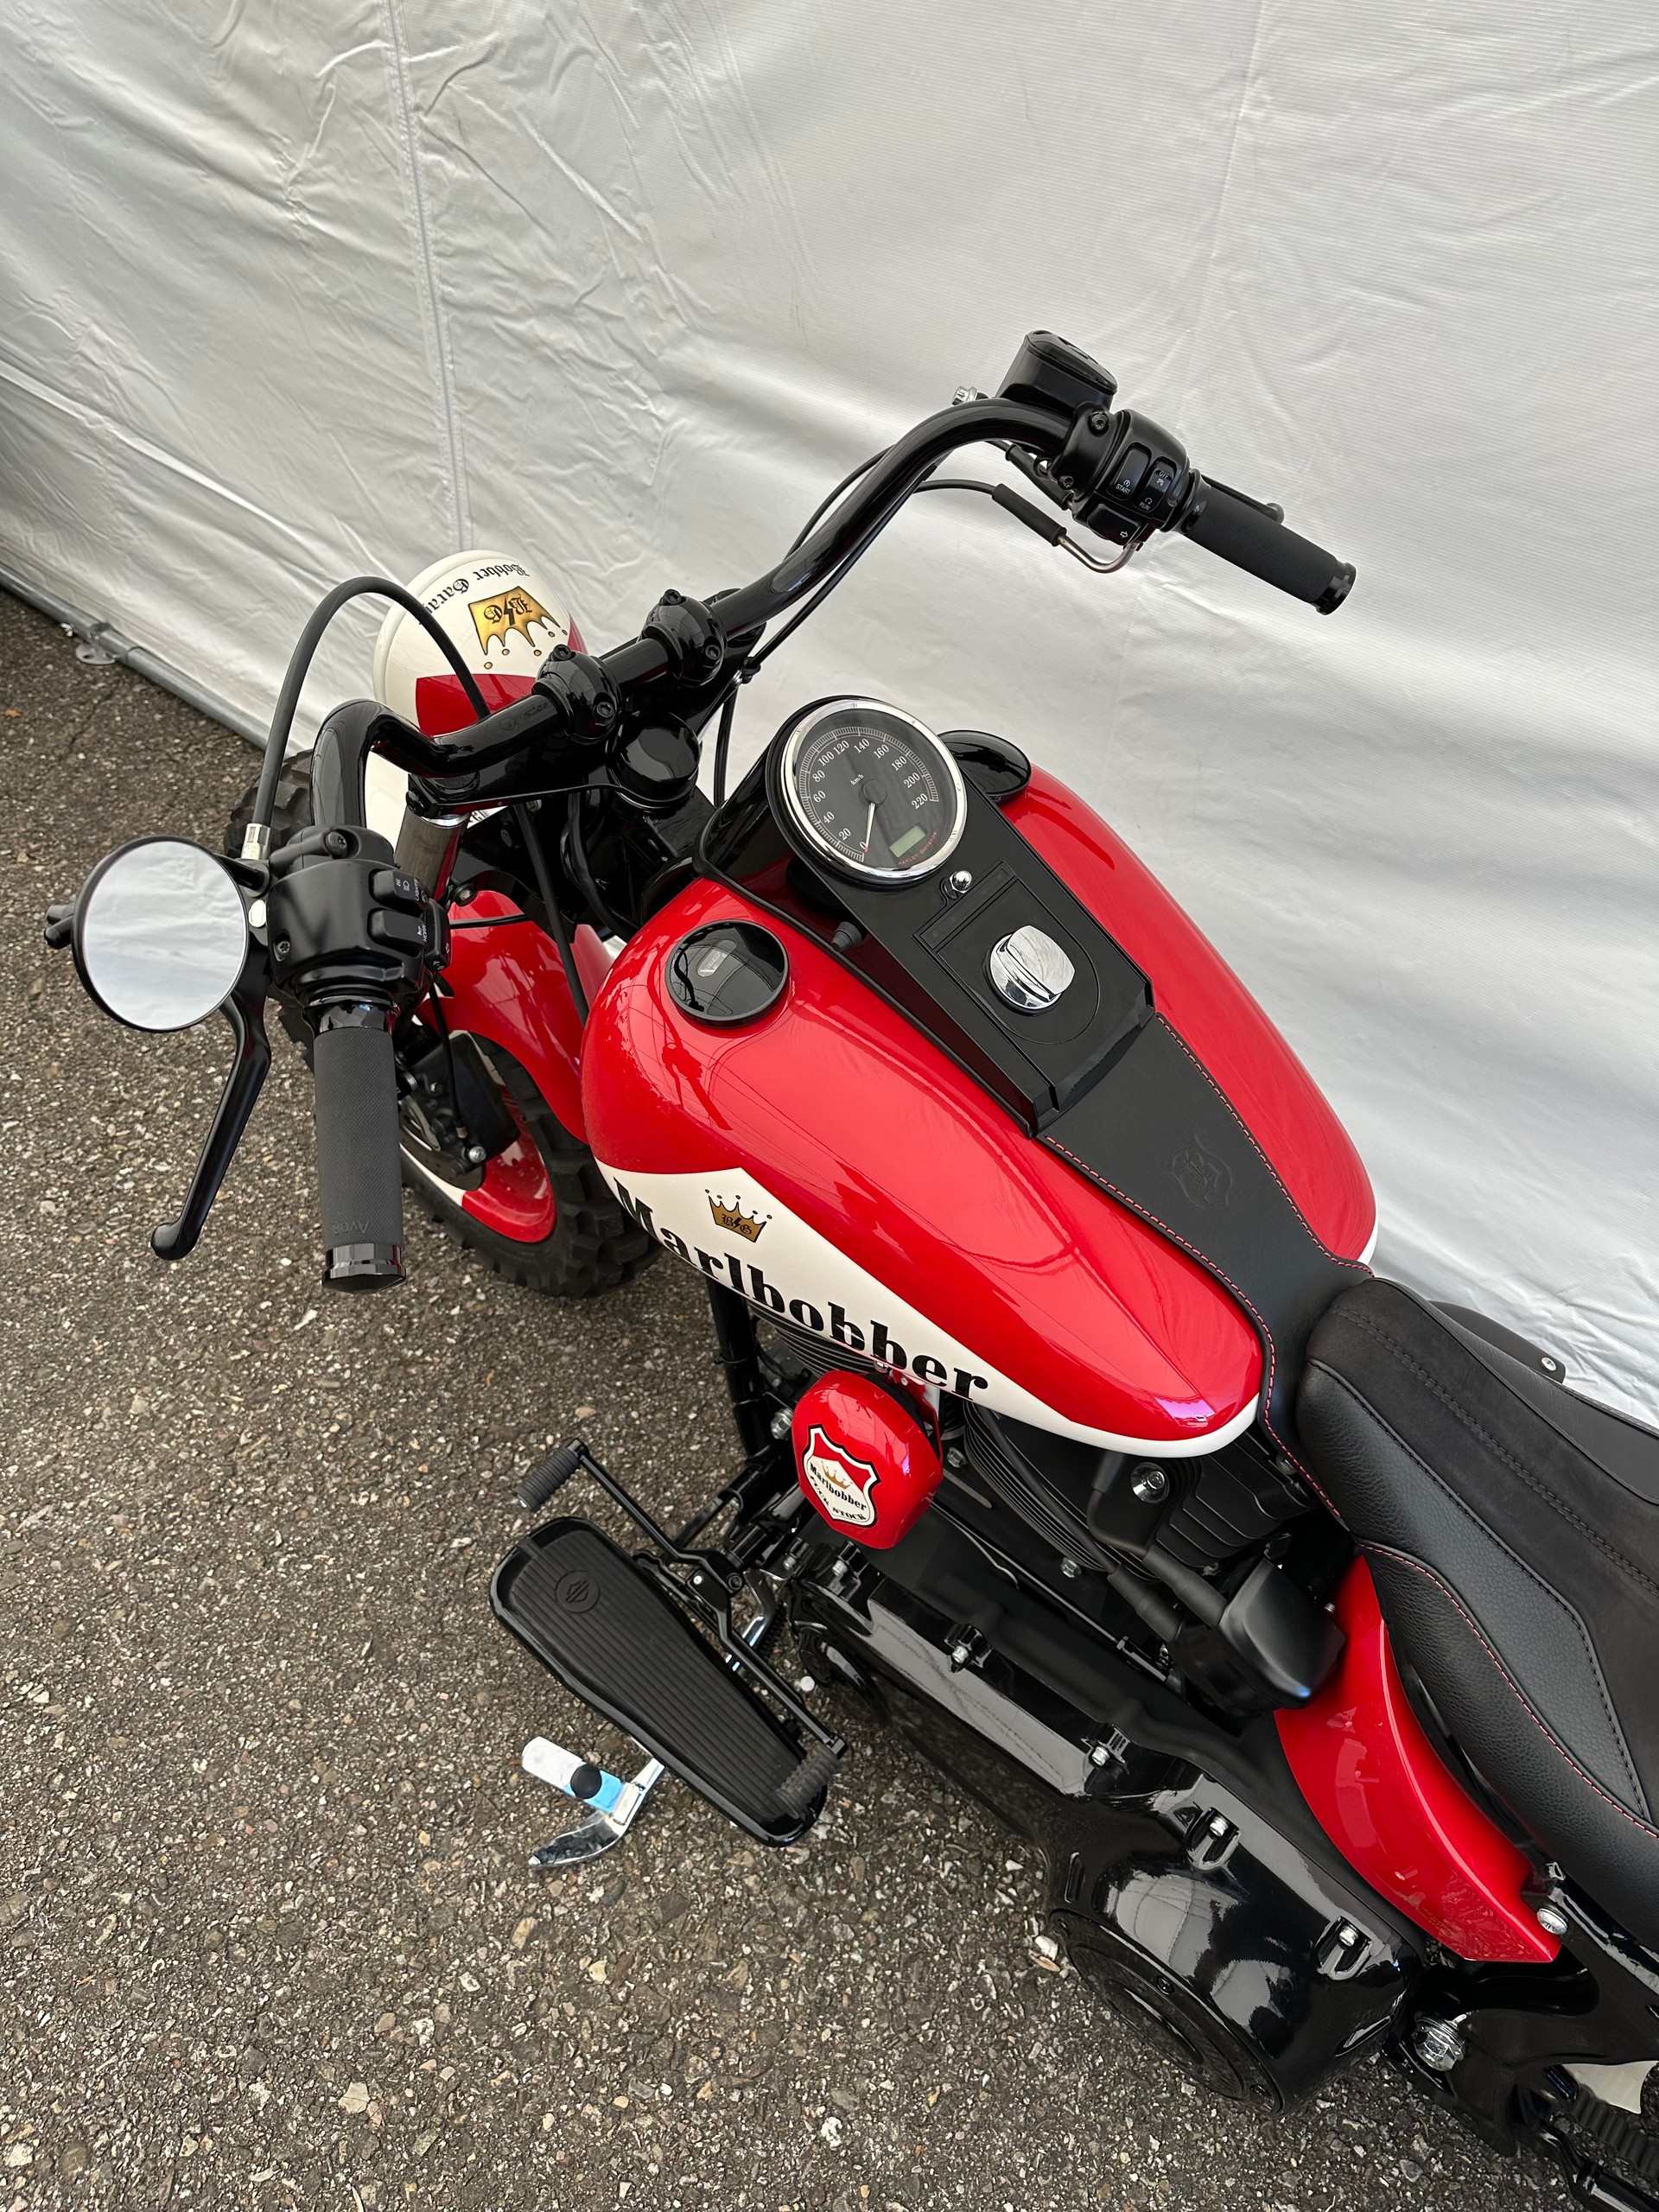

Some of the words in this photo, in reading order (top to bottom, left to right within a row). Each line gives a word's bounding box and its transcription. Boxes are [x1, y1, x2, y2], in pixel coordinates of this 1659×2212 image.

[1159, 470, 1170, 480] OFF
[1115, 483, 1131, 495] START
[1138, 501, 1151, 512] RUN
[473, 563, 531, 581] Bobber
[833, 740, 849, 755] 120
[854, 738, 870, 753] 140
[873, 744, 890, 759] 160
[817, 751, 835, 766] 100
[891, 755, 907, 771] 180
[812, 769, 825, 783] 80
[849, 773, 864, 785] km/h
[903, 772, 920, 788] 200
[812, 790, 826, 803] 60
[911, 792, 928, 810] 220
[823, 811, 835, 823] 40
[838, 828, 851, 841] 20
[859, 841, 868, 850] 0
[395, 878, 402, 887] HI
[613, 1177, 989, 1402] Marlbobber
[810, 1462, 868, 1511] Marlbobber
[832, 1507, 868, 1521] STOCK
